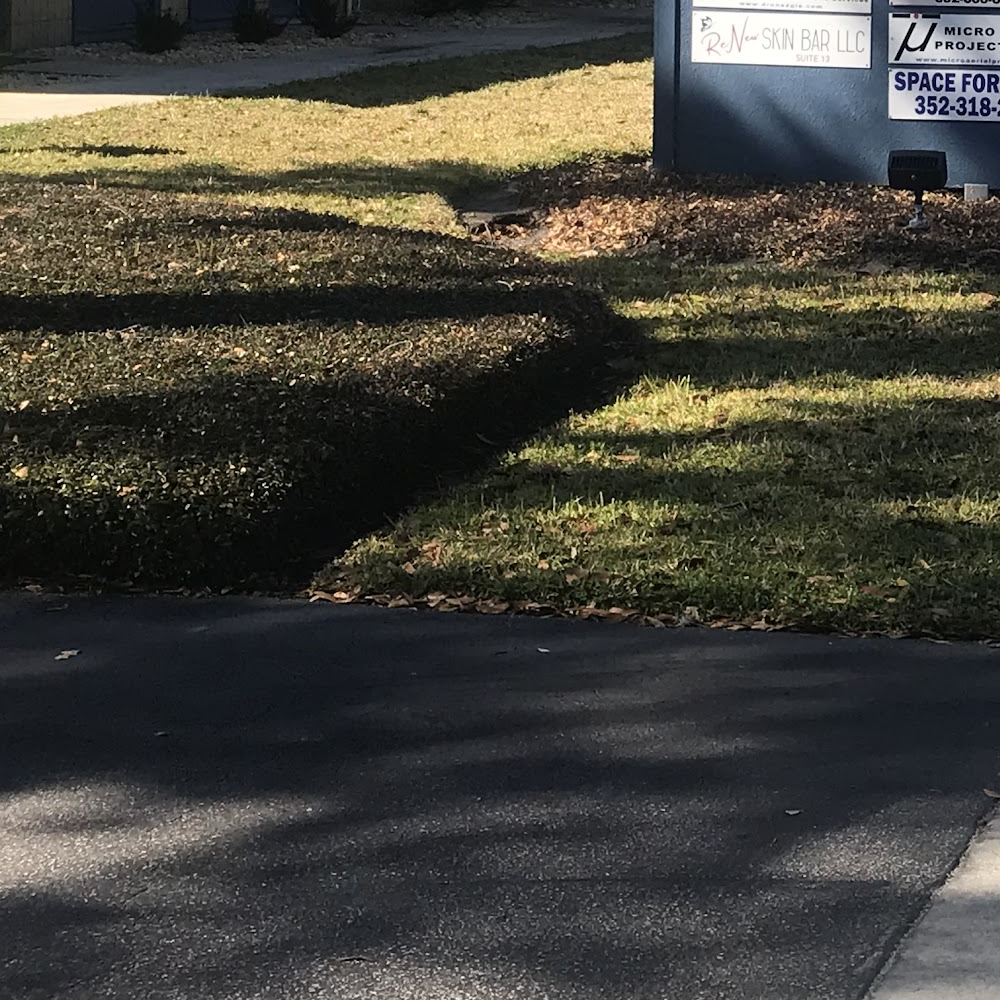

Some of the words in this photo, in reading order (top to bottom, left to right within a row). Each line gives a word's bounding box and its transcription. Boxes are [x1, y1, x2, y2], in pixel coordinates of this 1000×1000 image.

[762, 28, 795, 51] SKIN
[801, 29, 830, 51] BAR
[837, 30, 866, 53] LLC
[944, 27, 995, 36] MICRO
[894, 72, 956, 92] SPACE
[962, 73, 999, 93] FOR
